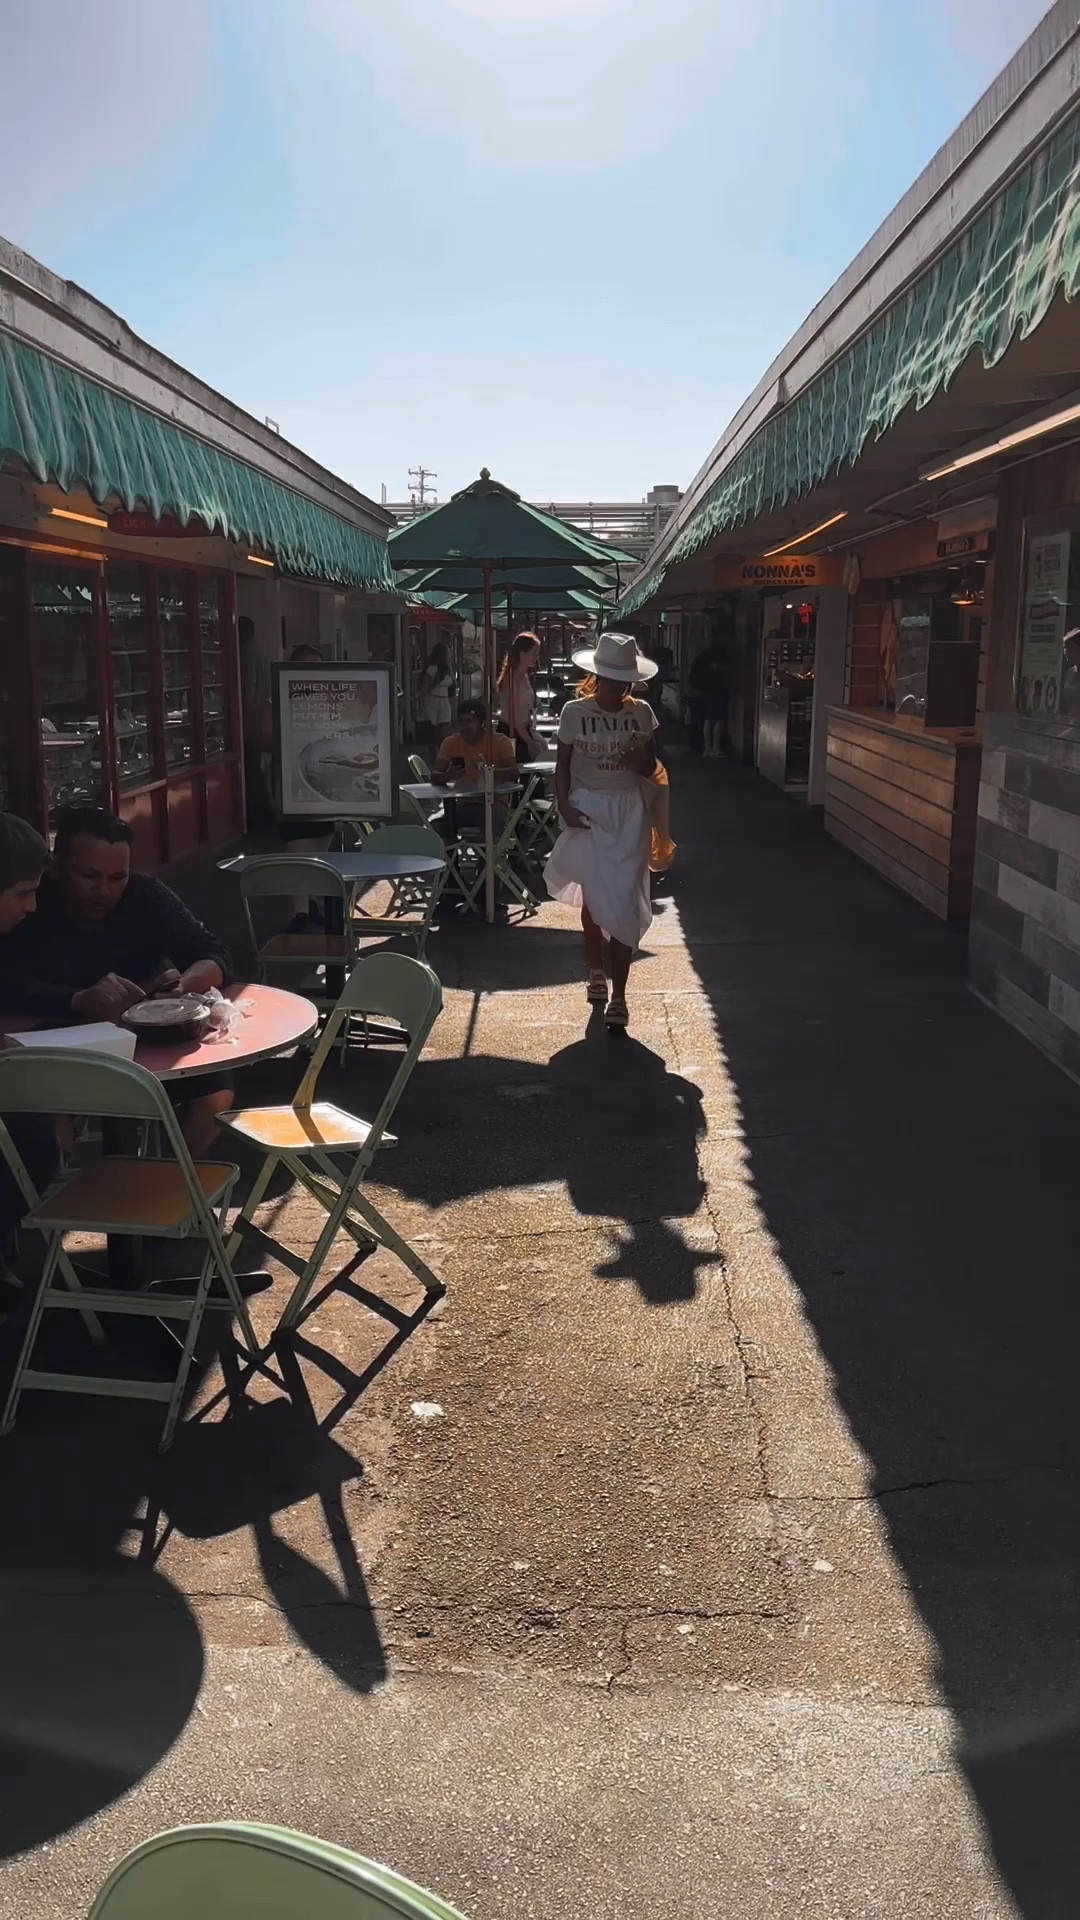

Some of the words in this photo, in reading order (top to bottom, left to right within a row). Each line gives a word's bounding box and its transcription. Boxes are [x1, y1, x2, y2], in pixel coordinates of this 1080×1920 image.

[742, 564, 816, 578] NONNA'S
[291, 683, 329, 691] WHEN
[331, 683, 358, 691] LIFE
[291, 692, 328, 701] GIVES
[330, 692, 355, 701] YOU
[292, 712, 317, 721] PUT
